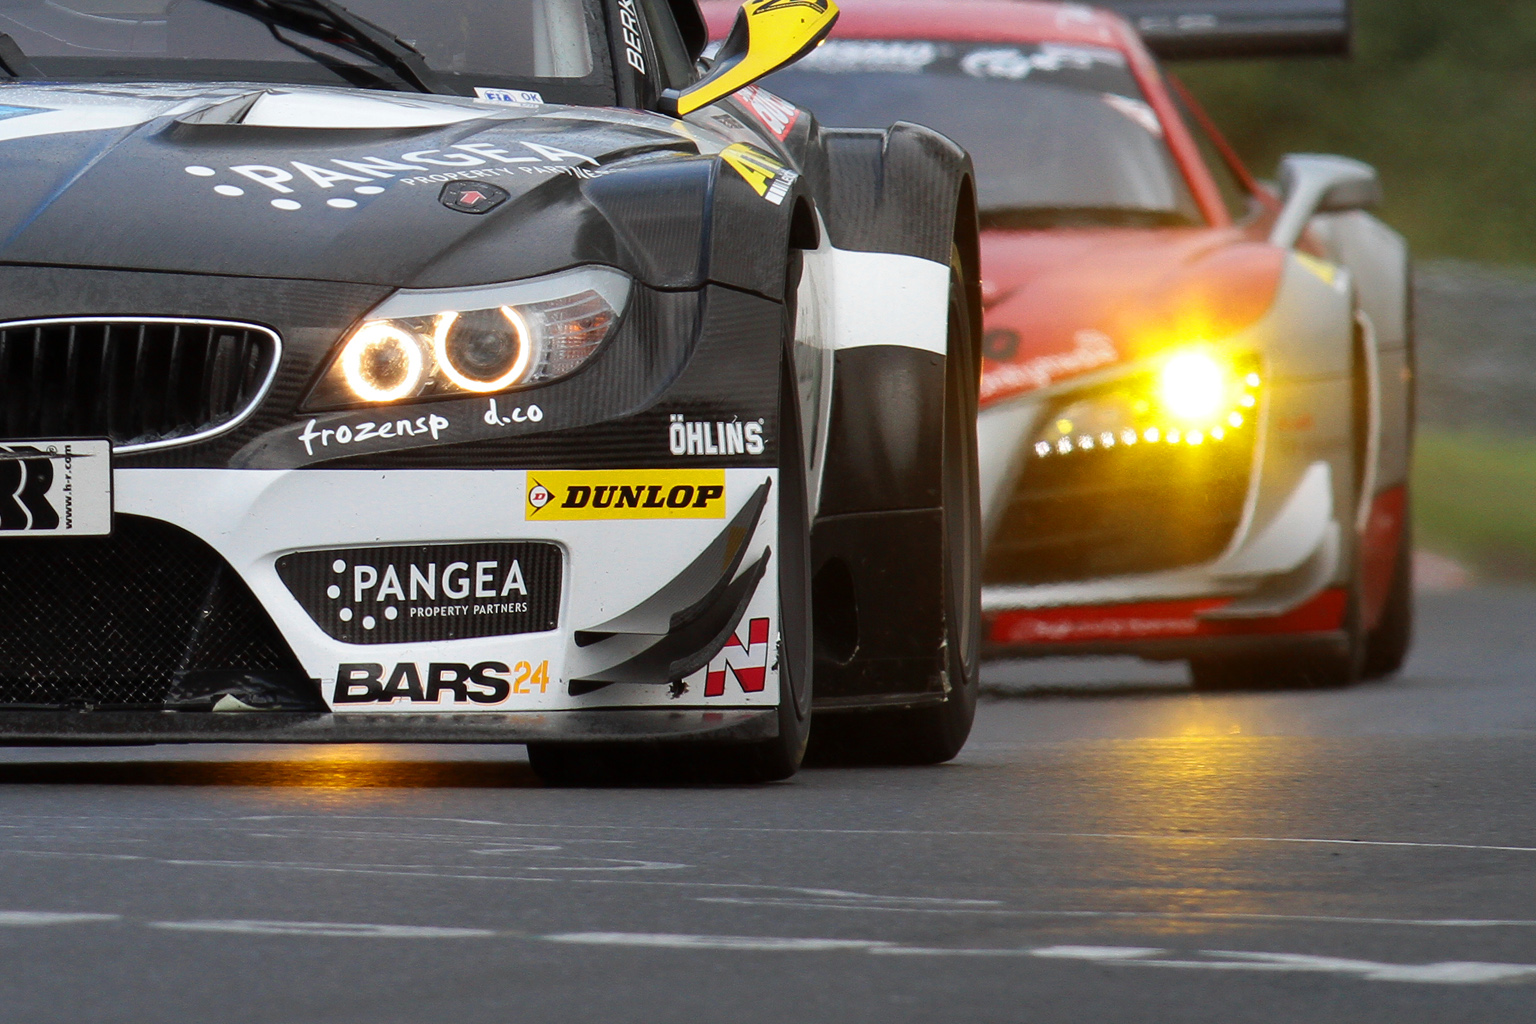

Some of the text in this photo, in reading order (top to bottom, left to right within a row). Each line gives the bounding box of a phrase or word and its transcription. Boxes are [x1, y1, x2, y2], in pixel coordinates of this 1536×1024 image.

[521, 92, 541, 103] OK
[230, 141, 600, 193] PANGEA
[401, 167, 510, 186] PROPERTY
[298, 414, 449, 456] frozensp
[668, 414, 764, 456] ÖHLINS
[63, 444, 73, 530] www.h-r.com
[561, 485, 723, 509] DUNLOP
[352, 559, 528, 603] PANGEA
[409, 600, 529, 618] PROPERTY PARTNERS
